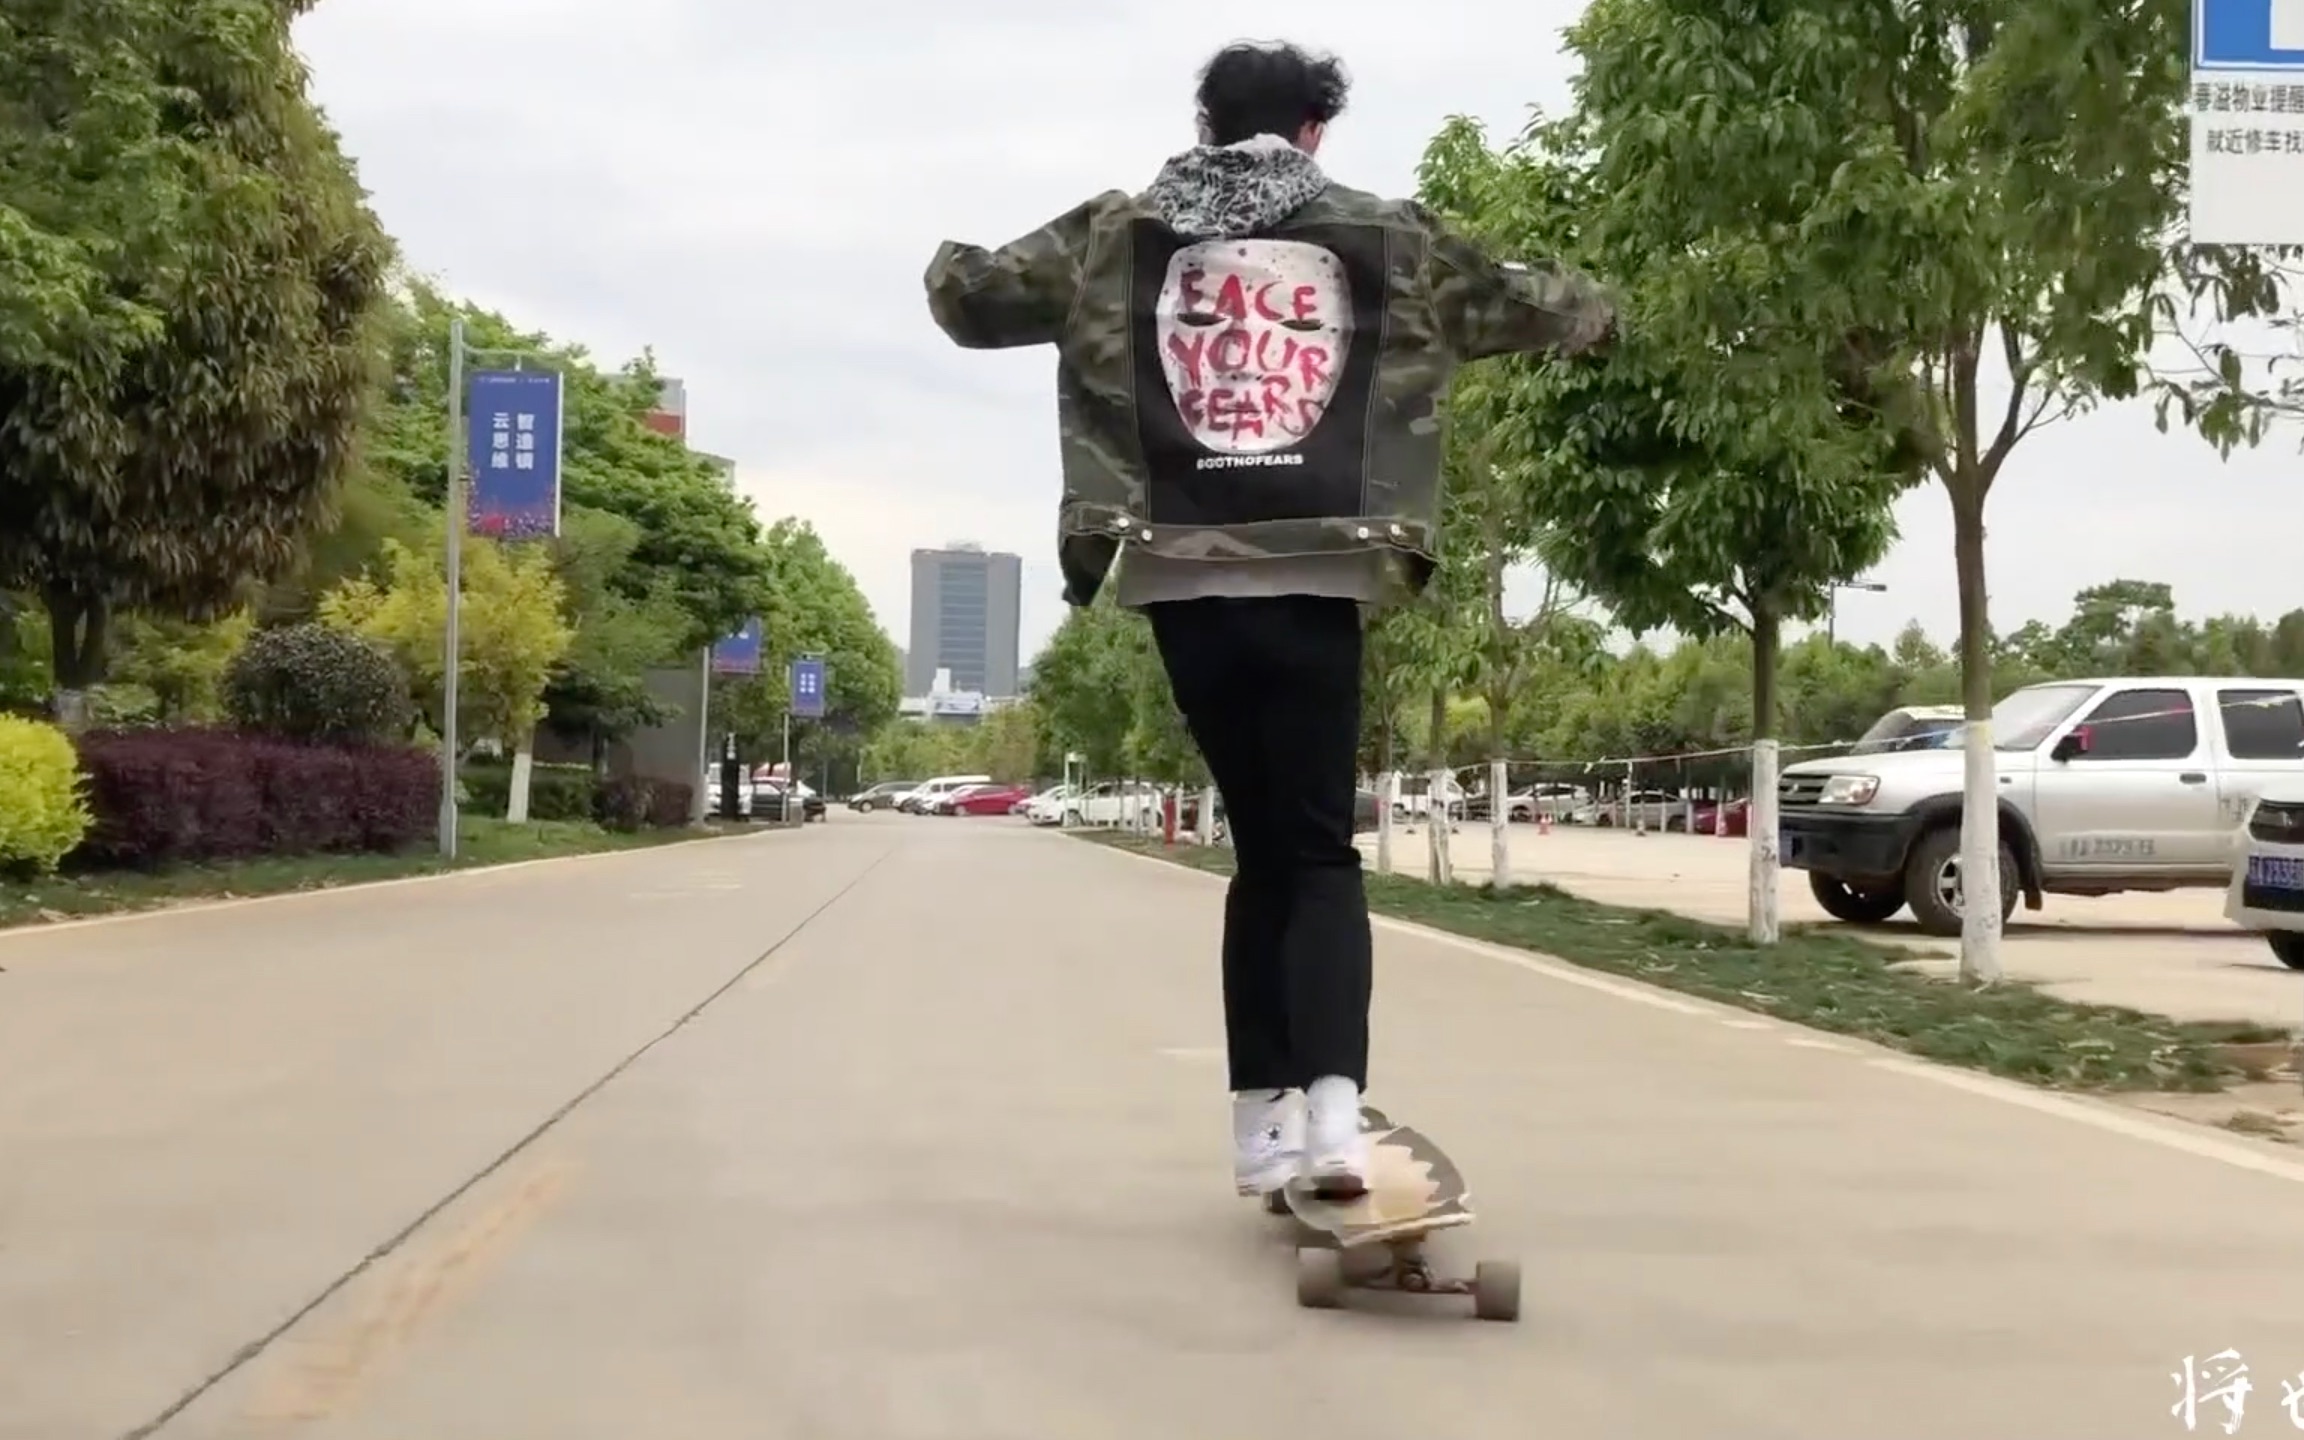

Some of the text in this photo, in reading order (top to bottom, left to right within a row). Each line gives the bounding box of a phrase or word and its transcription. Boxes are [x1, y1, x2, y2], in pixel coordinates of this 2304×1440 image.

[1179, 268, 1318, 321] FACE
[1168, 327, 1333, 392] YOUR
[1178, 374, 1326, 442] FEARS
